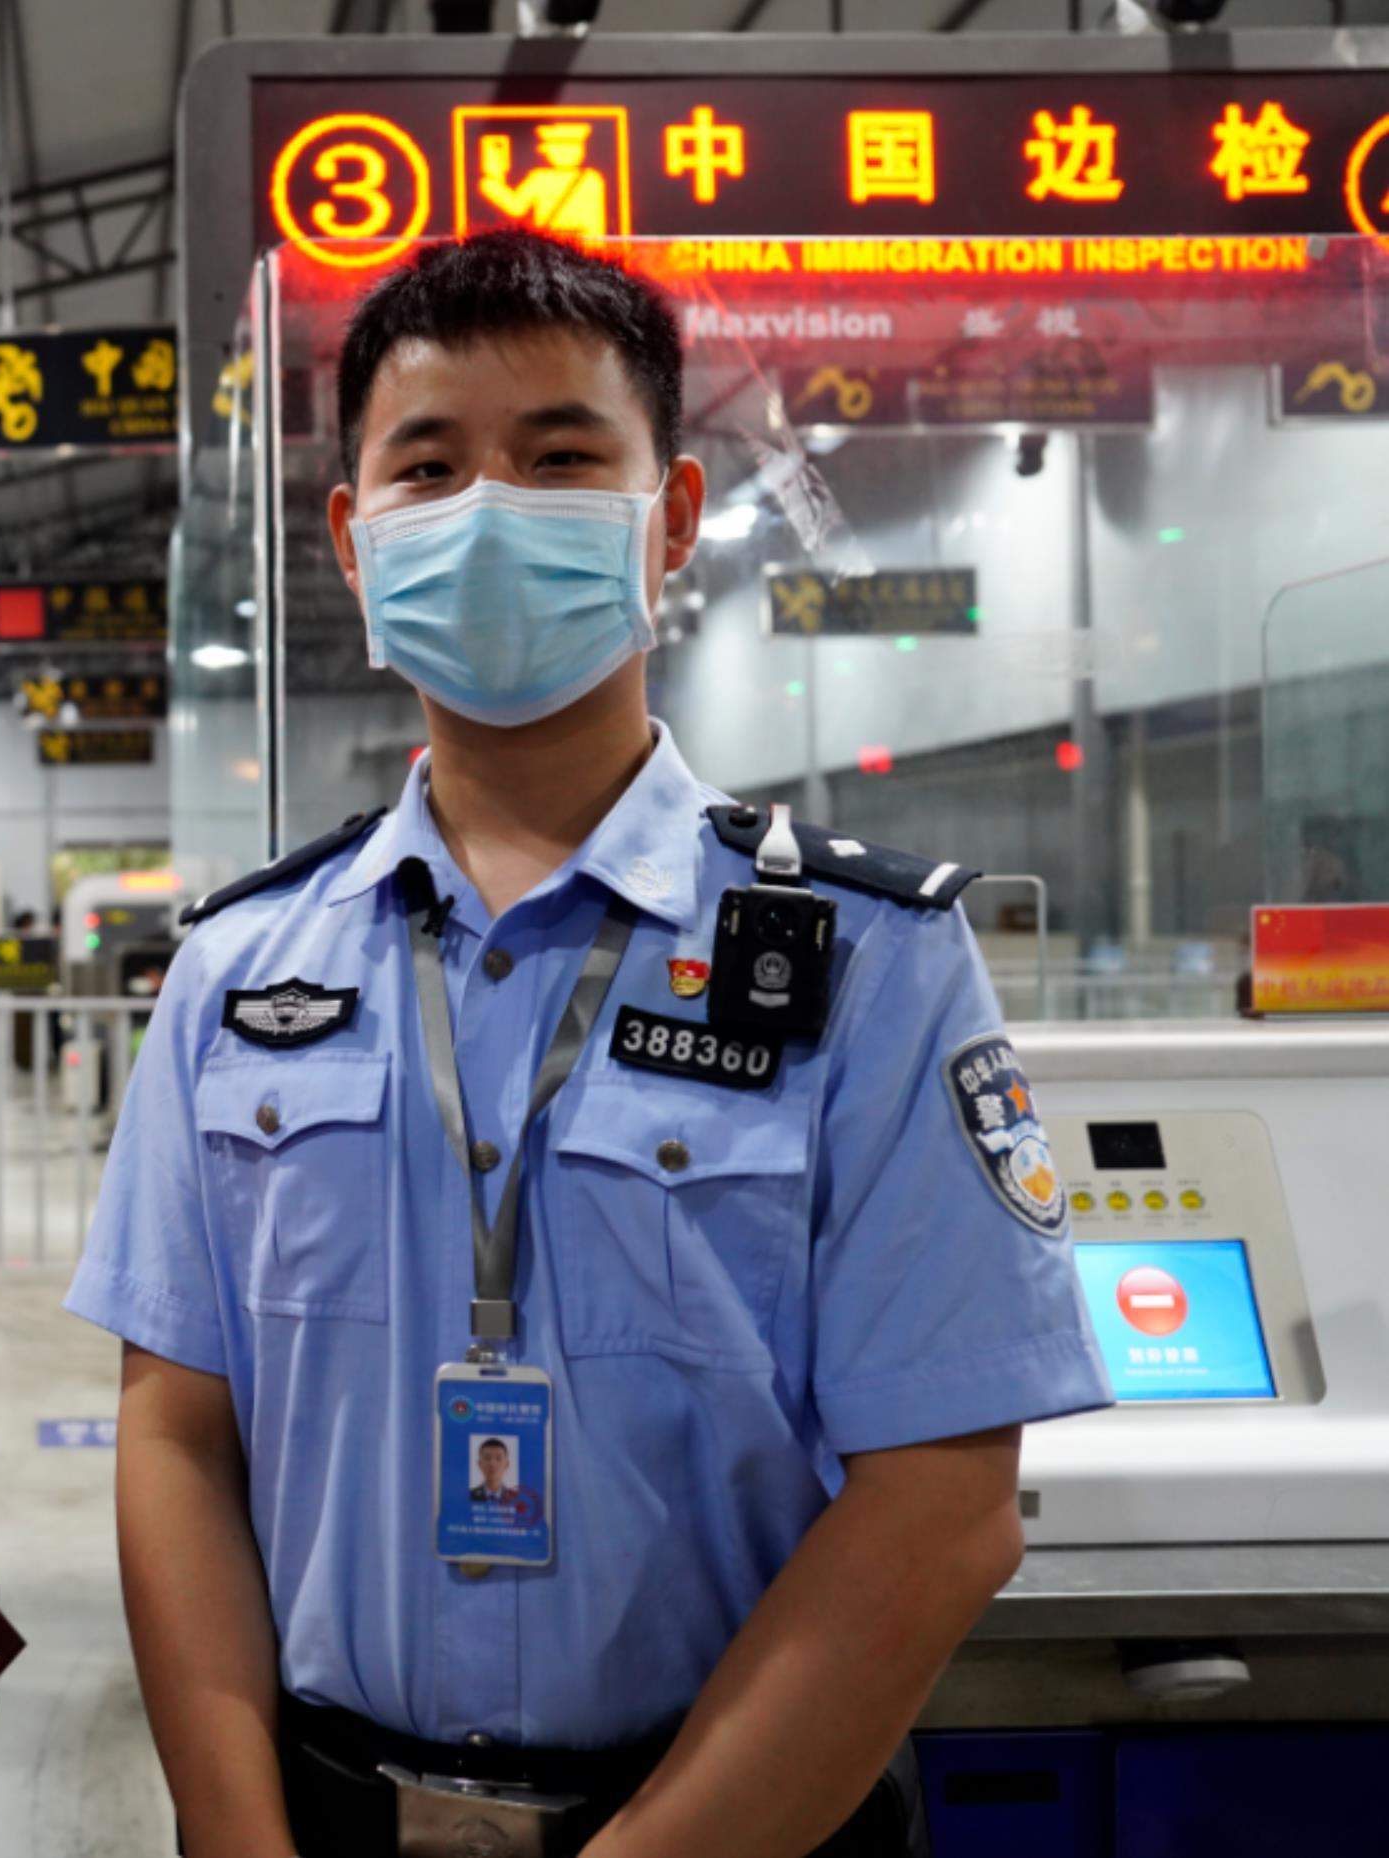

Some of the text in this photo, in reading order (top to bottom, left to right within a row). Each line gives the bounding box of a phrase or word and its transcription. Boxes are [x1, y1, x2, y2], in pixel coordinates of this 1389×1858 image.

[664, 102, 1309, 203] 中国边检
[668, 236, 1308, 273] CHINA IMMIGRATION INSPECTION
[684, 305, 892, 338] Maxvision
[623, 1019, 770, 1077] 388360
